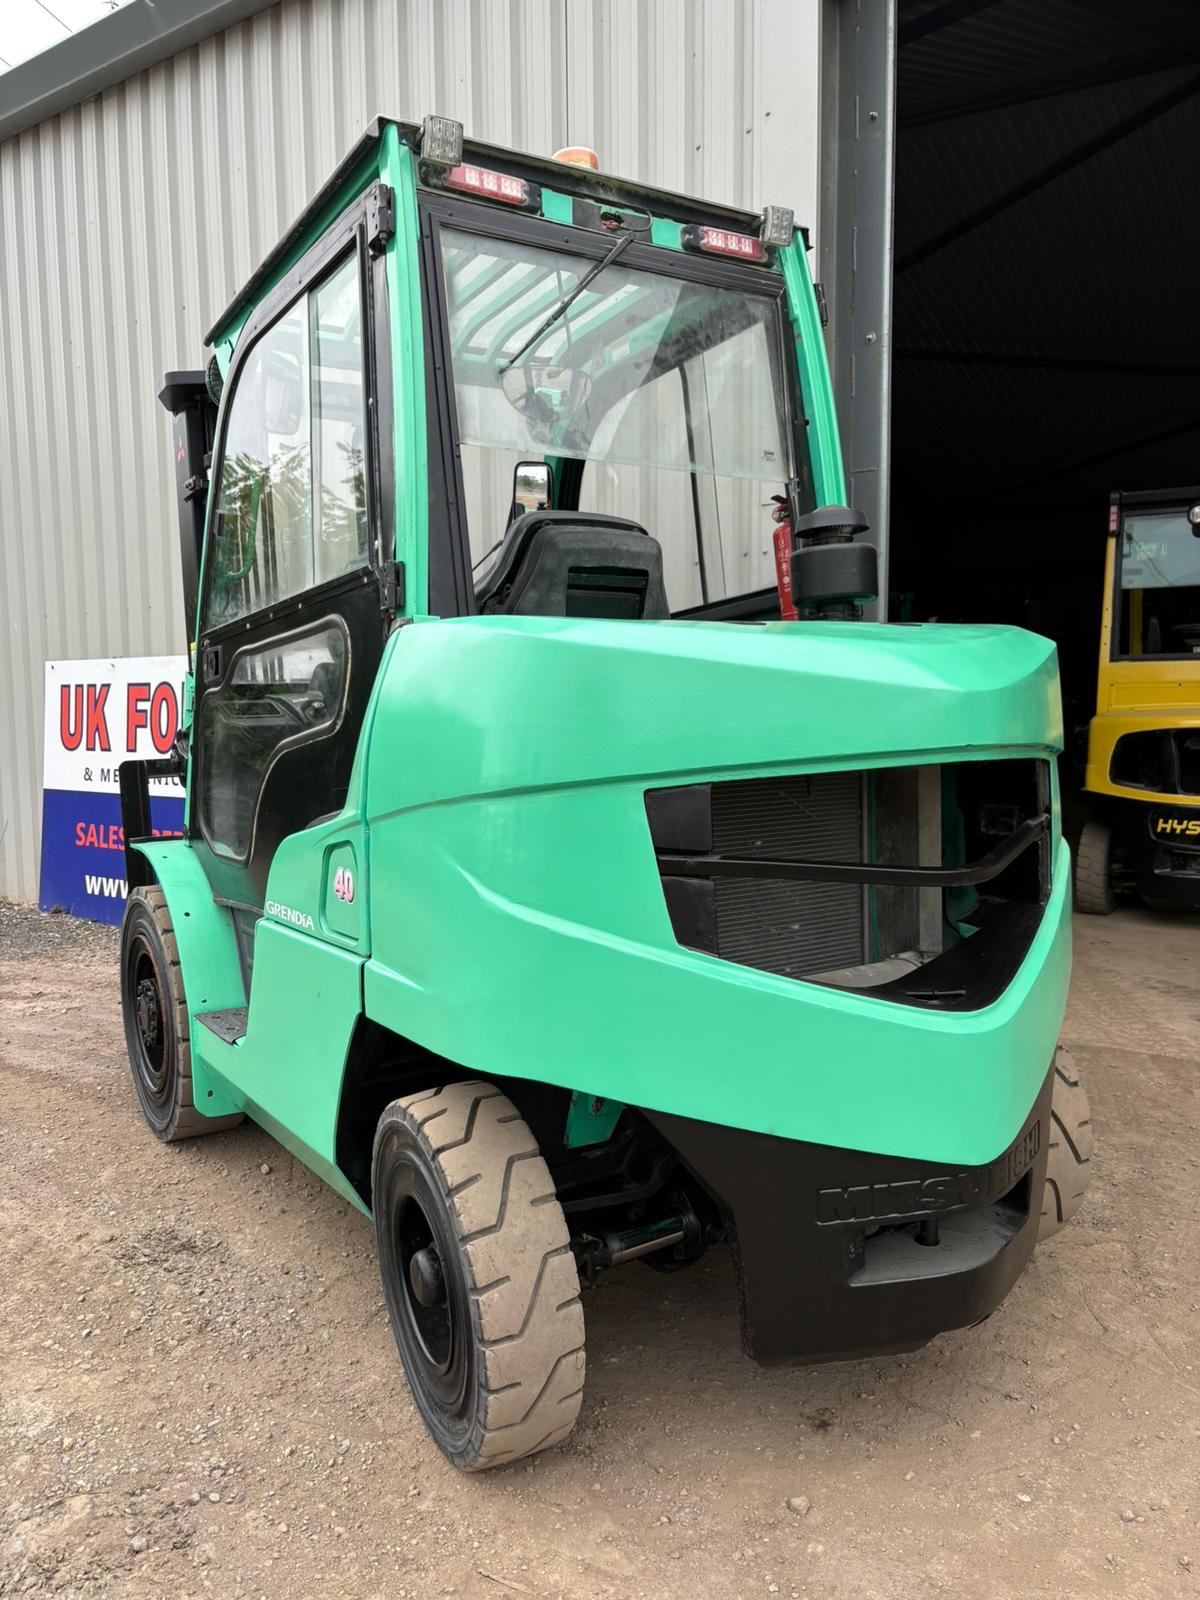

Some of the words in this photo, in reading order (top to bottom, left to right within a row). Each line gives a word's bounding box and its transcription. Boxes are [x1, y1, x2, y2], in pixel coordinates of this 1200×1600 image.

[59, 682, 112, 752] UK
[126, 681, 185, 754] FO
[83, 767, 93, 782] &
[334, 866, 355, 904] 40
